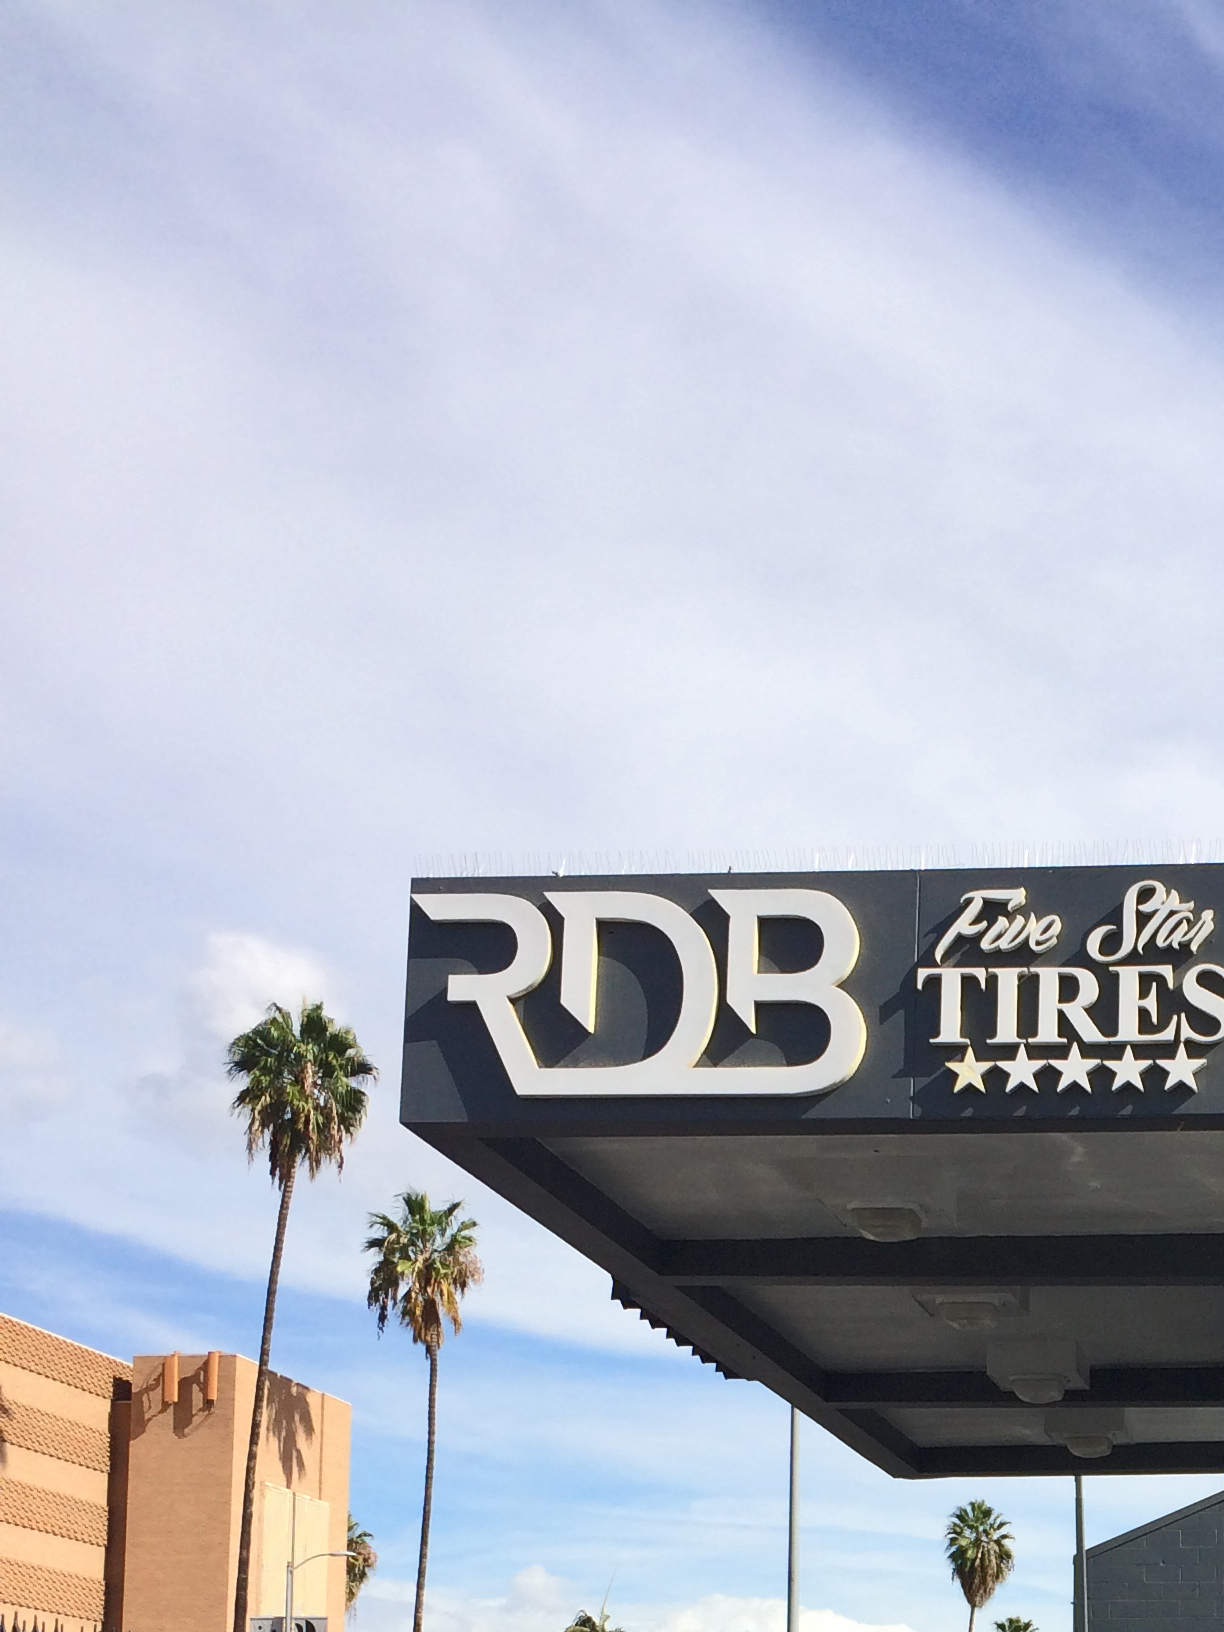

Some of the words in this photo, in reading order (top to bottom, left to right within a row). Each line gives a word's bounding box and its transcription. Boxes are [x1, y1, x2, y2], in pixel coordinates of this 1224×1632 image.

[411, 889, 867, 1097] RDB
[935, 886, 1061, 963] Five
[1086, 880, 1216, 963] Star
